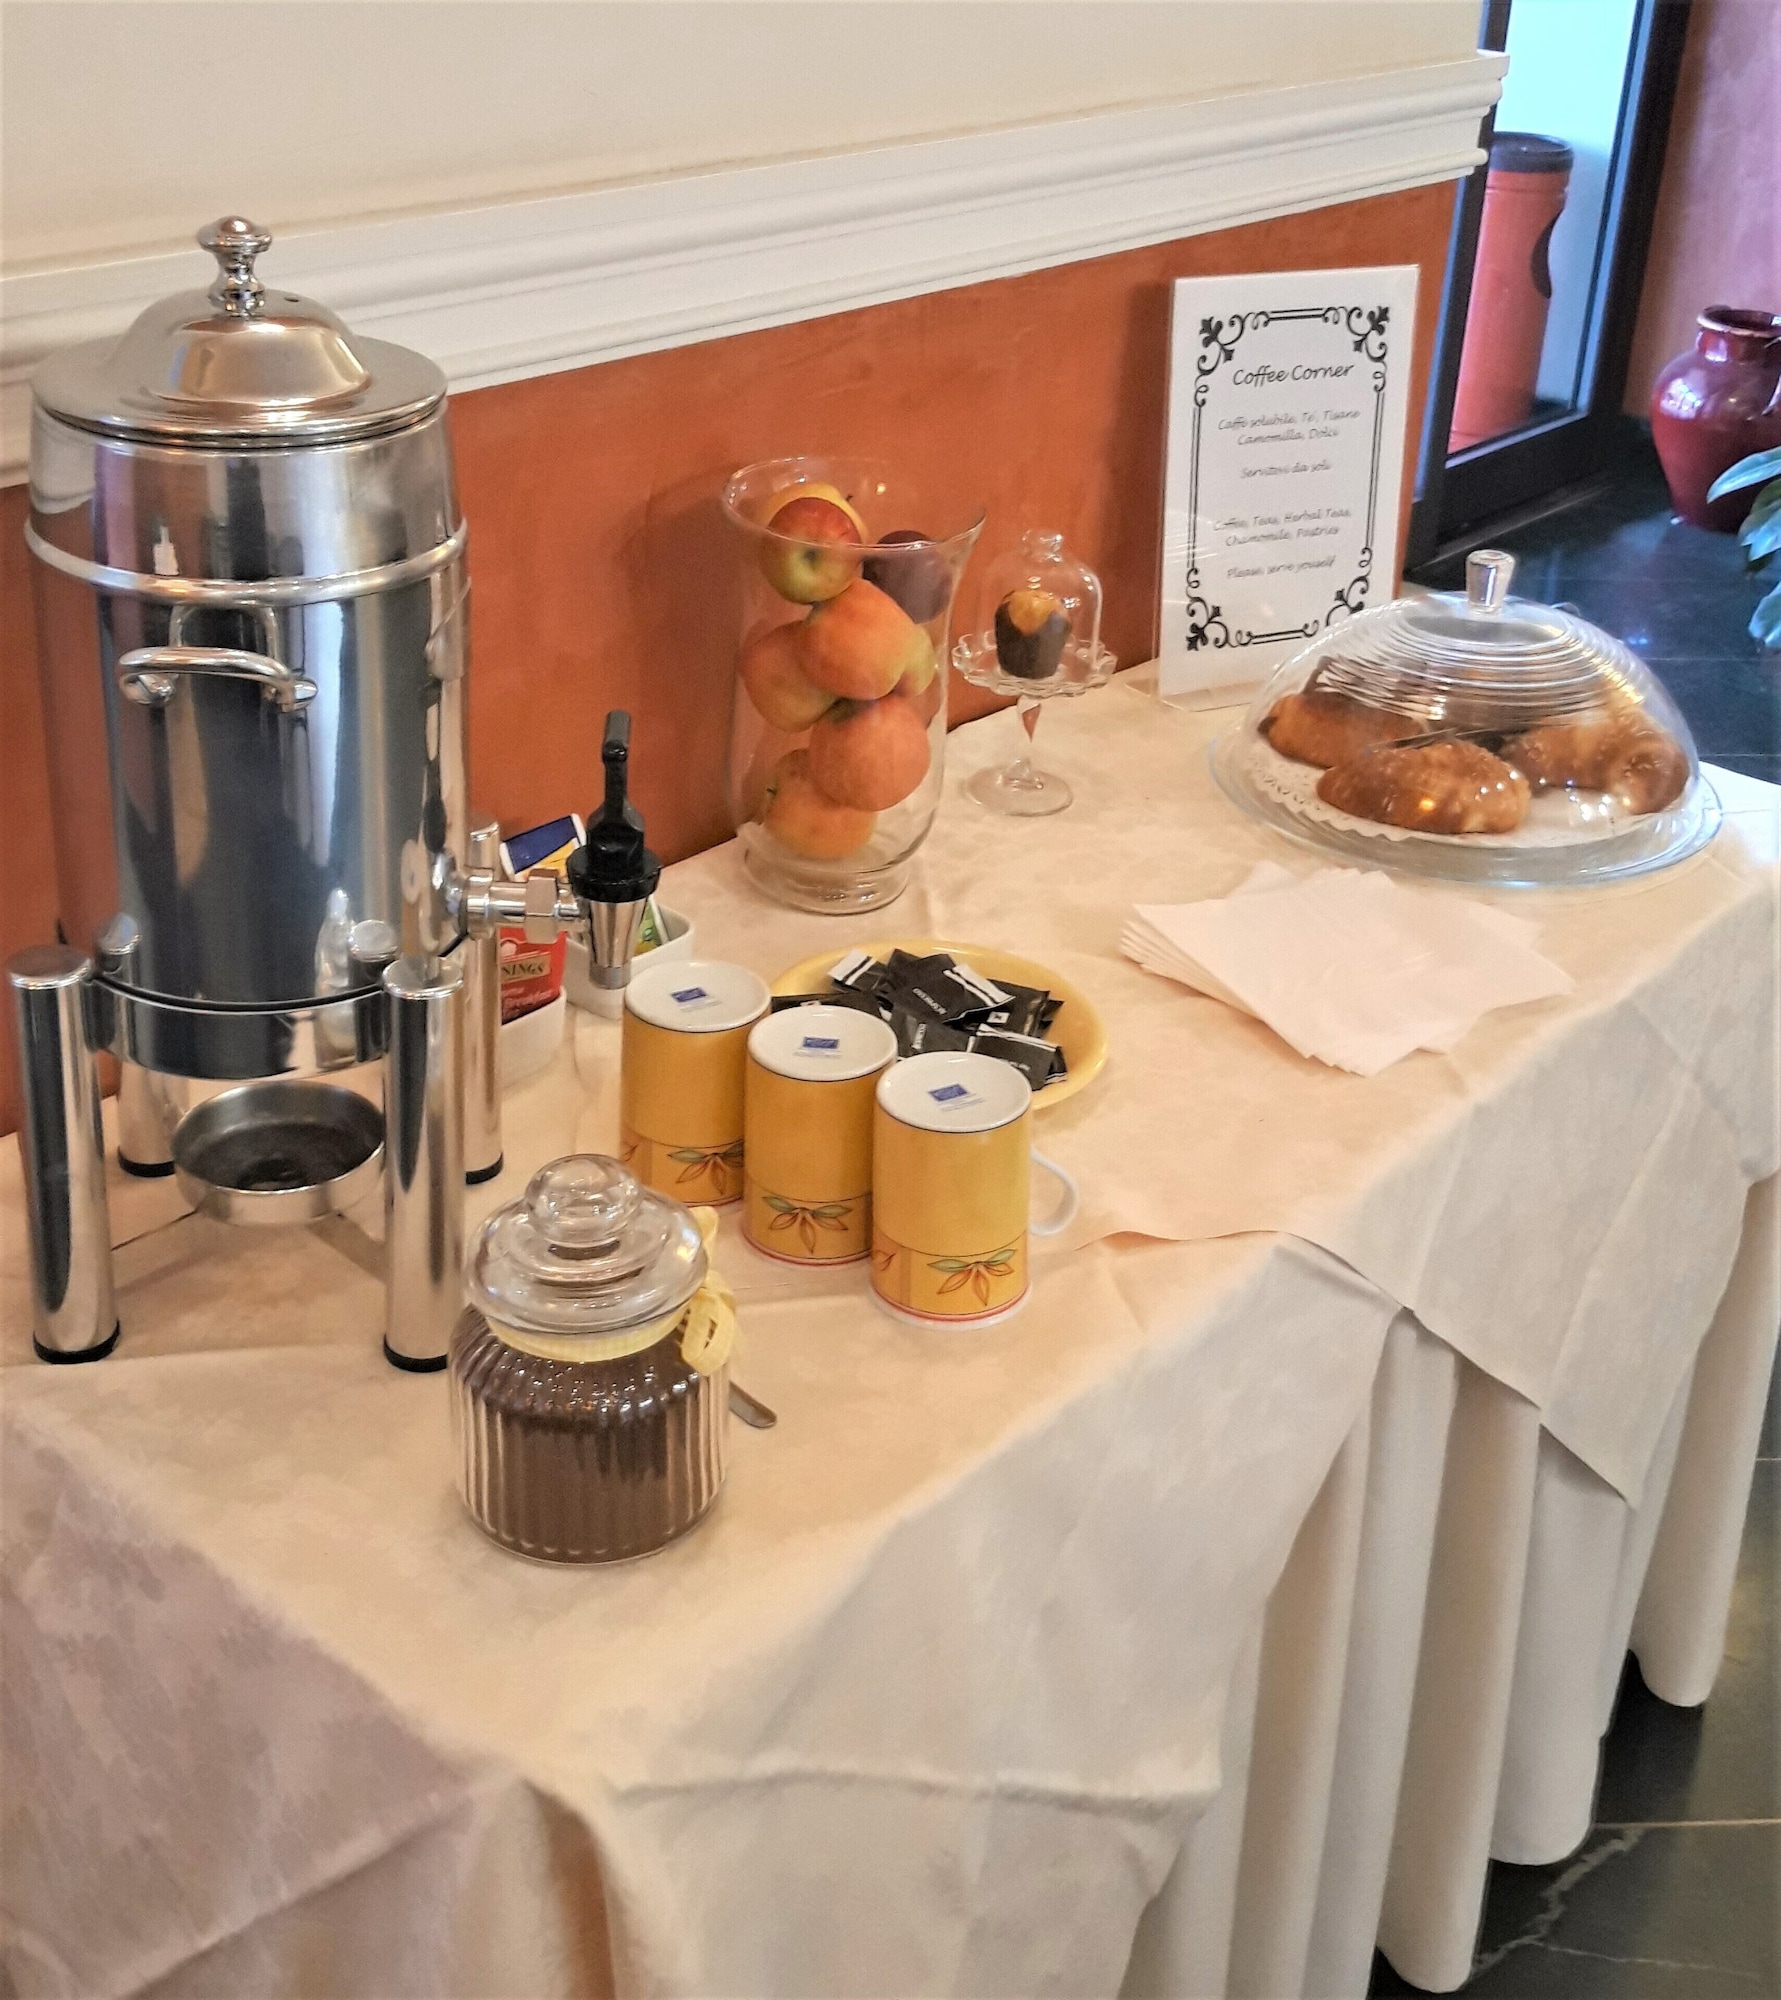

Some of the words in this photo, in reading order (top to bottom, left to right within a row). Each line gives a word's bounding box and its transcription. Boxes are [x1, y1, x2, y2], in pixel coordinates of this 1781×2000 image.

[1233, 364, 1288, 387] Coffee
[1292, 364, 1356, 380] Corner
[1284, 509, 1322, 523] Herbal
[1296, 525, 1341, 539] Pastries
